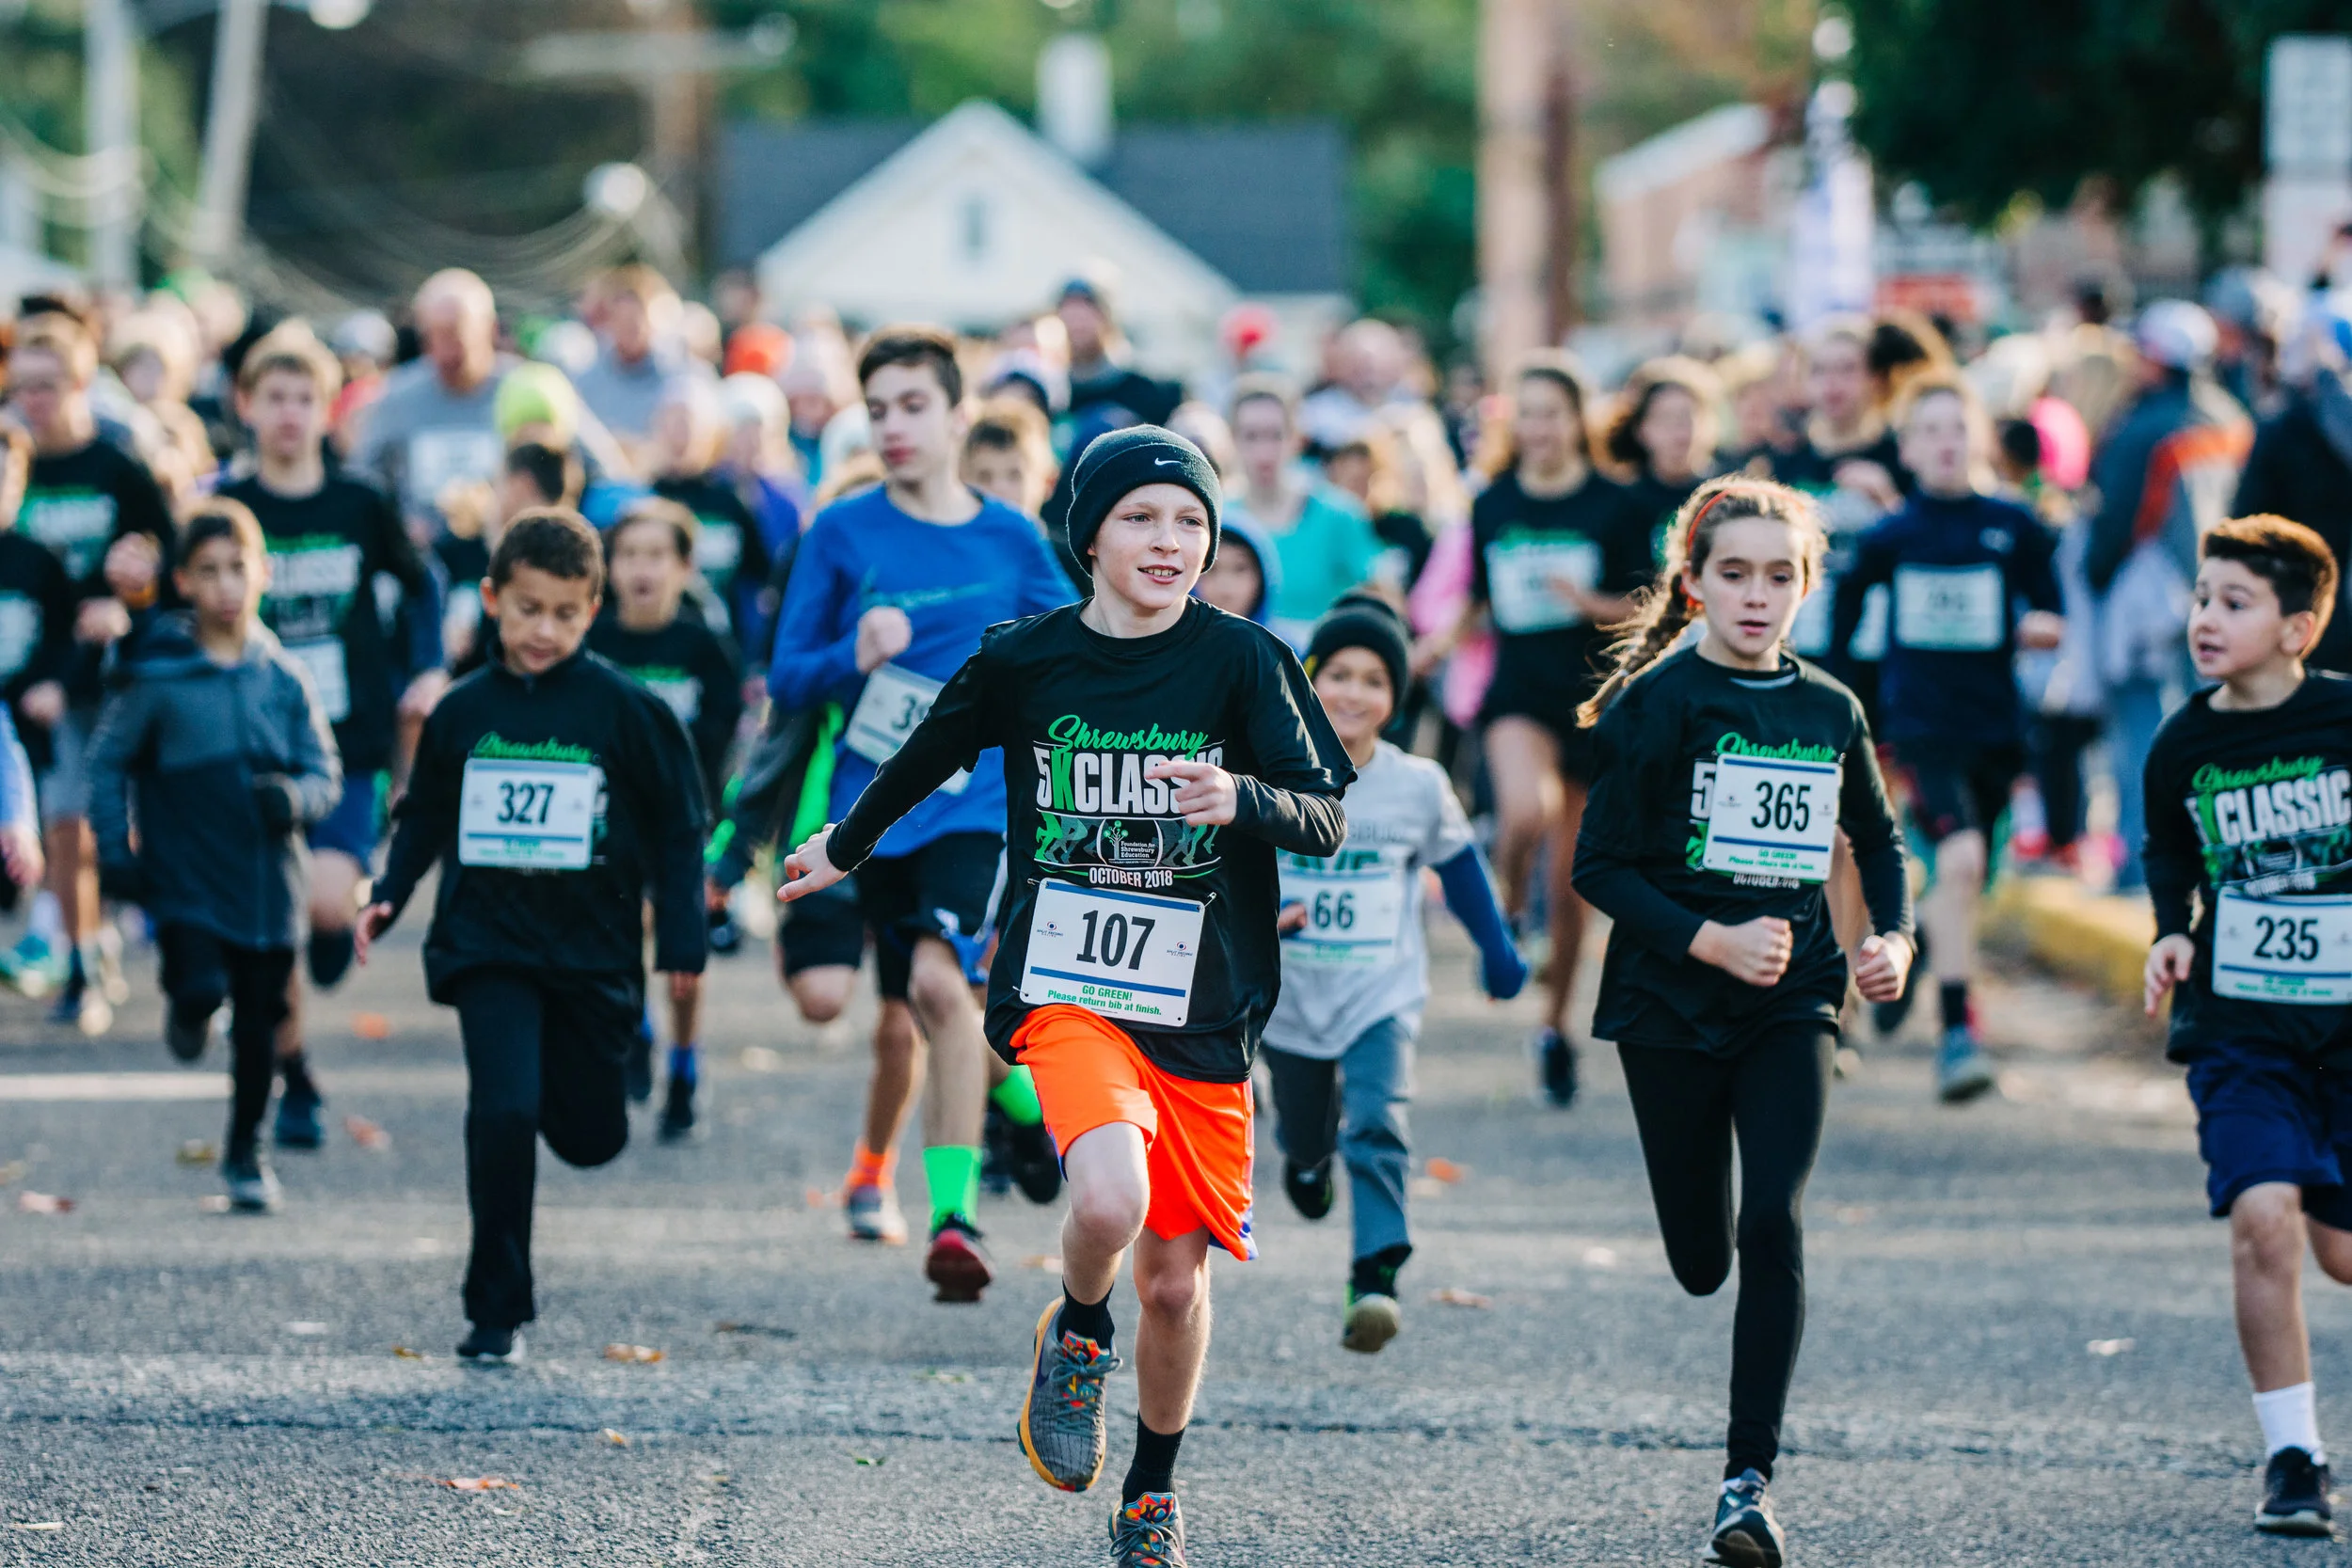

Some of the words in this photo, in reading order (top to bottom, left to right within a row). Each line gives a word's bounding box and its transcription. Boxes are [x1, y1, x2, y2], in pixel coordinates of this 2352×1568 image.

[1048, 714, 1208, 759] Shrewsbury
[497, 781, 555, 825] 327
[1751, 781, 1811, 832] 365
[2215, 769, 2351, 847] CLASSIC
[1120, 847, 1155, 855] Shrewsbury
[1089, 866, 1142, 888] OCTOBER
[1144, 869, 1173, 888] 2018
[1314, 890, 1355, 929] 66
[1076, 910, 1156, 971] 107
[2254, 916, 2319, 961] 235
[1047, 990, 1077, 1003] Please
[1078, 996, 1106, 1007] return
[1108, 999, 1122, 1009] bib
[1124, 1003, 1134, 1012] at
[1136, 1004, 1162, 1016] finish.
[1082, 985, 1095, 995] GO
[1098, 987, 1133, 1001] GREEN!
